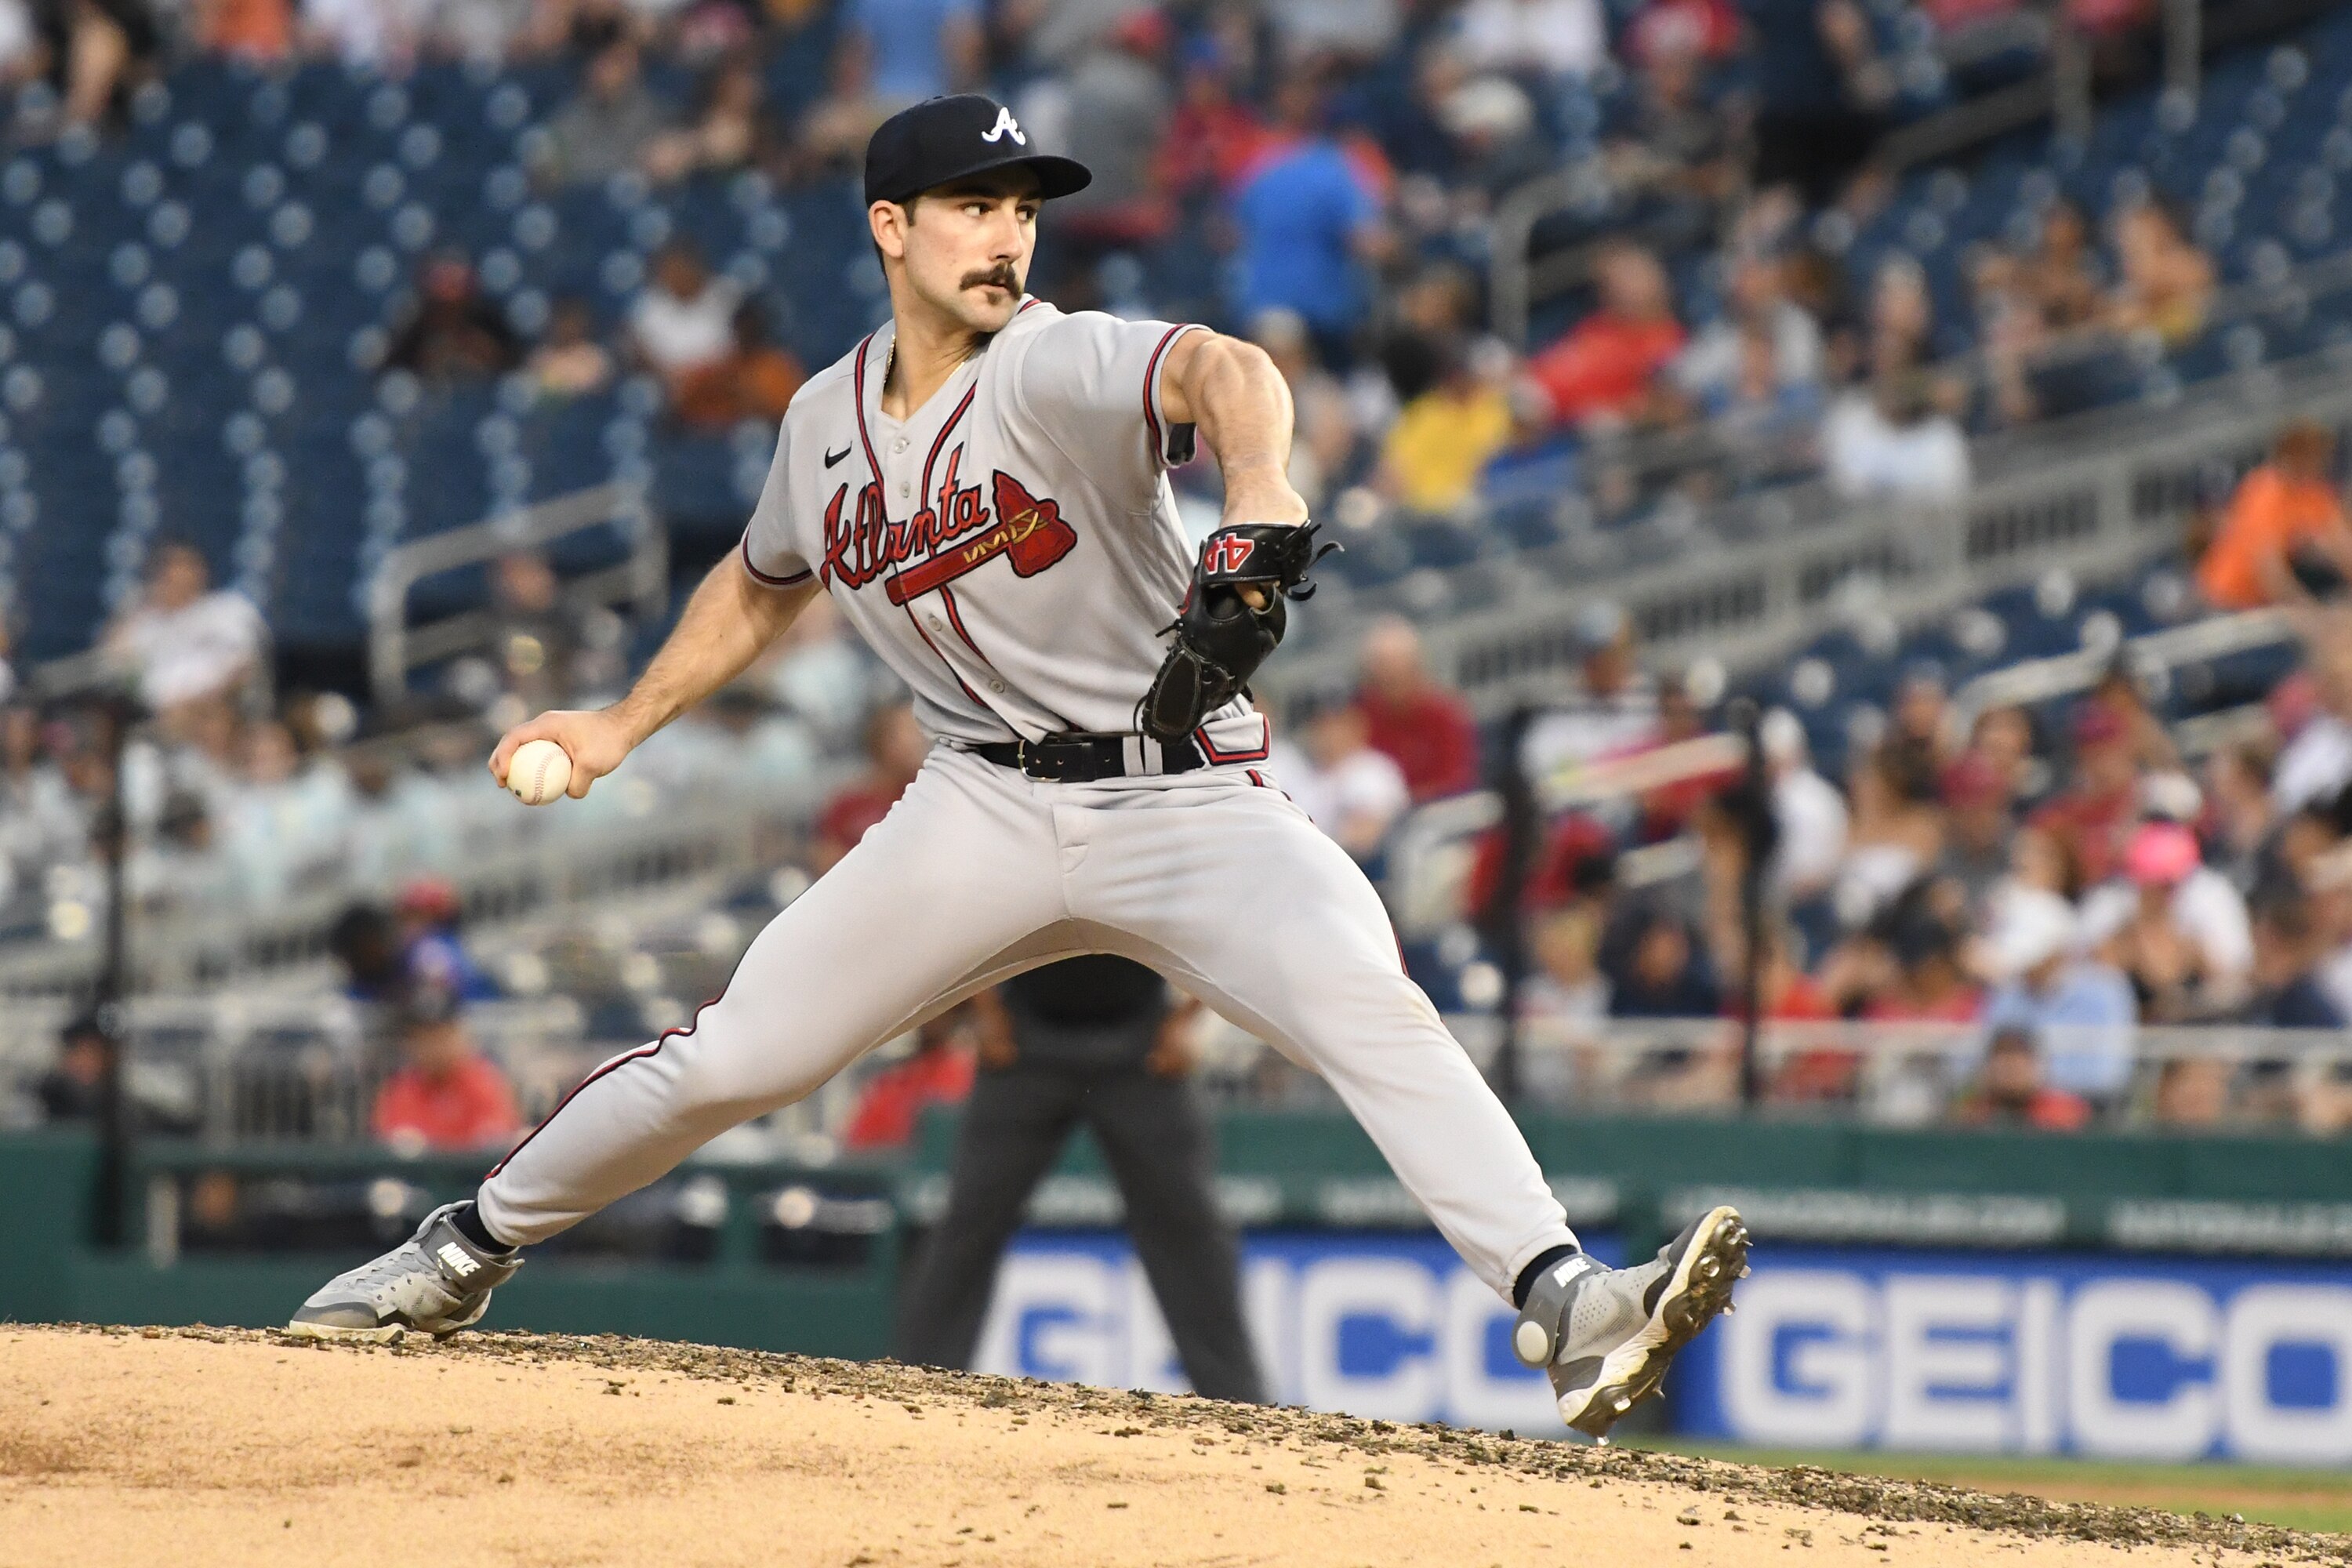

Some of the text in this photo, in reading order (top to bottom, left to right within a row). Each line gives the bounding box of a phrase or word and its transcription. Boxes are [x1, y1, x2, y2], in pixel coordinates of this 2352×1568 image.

[982, 107, 1026, 146] A
[820, 441, 990, 596] Atlanta
[437, 1241, 481, 1277] NIKE
[1553, 1258, 1591, 1287] NIKE
[1717, 1266, 2352, 1462] GEICO
